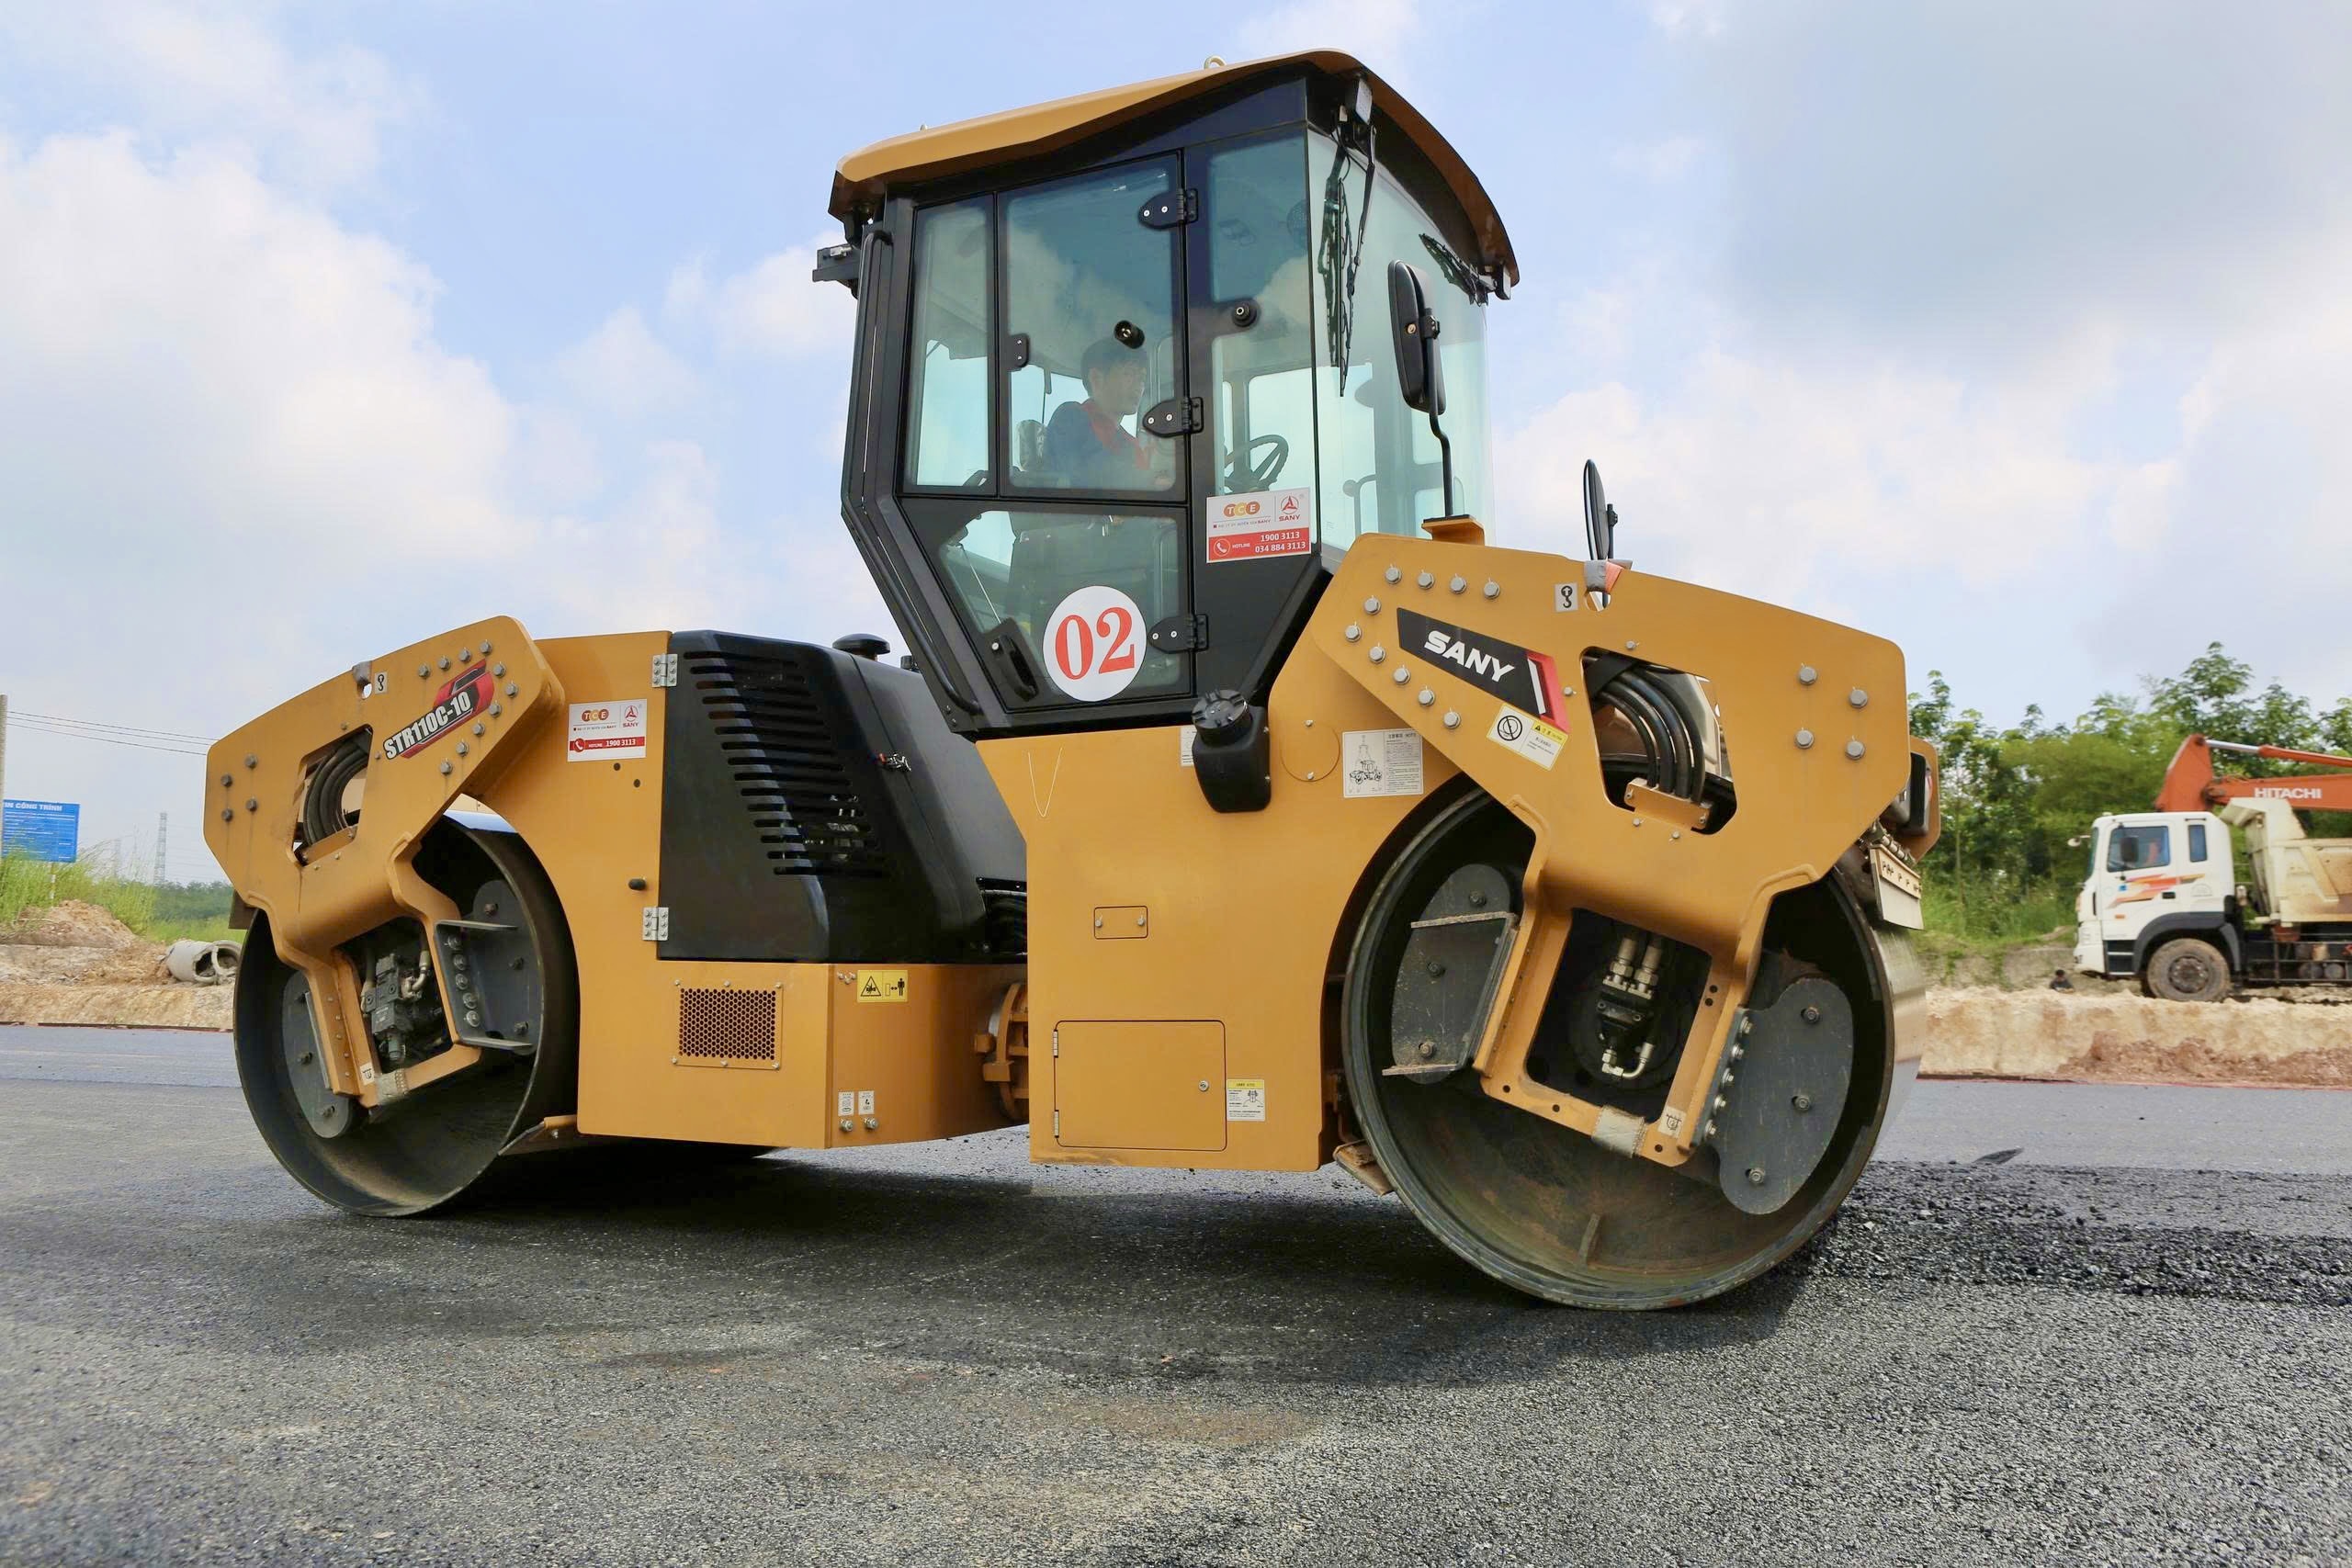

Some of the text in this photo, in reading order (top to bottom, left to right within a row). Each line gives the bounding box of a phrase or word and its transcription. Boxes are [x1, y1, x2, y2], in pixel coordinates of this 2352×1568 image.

[1226, 503, 1258, 515] TCE
[1261, 532, 1300, 542] 1900 3113
[1255, 541, 1306, 553] 034 884 3113
[1055, 607, 1135, 680] 02
[1424, 630, 1515, 682] SANY
[582, 710, 607, 720] TCE
[384, 691, 471, 759] STR110C-10
[2254, 787, 2322, 799] HITACHI
